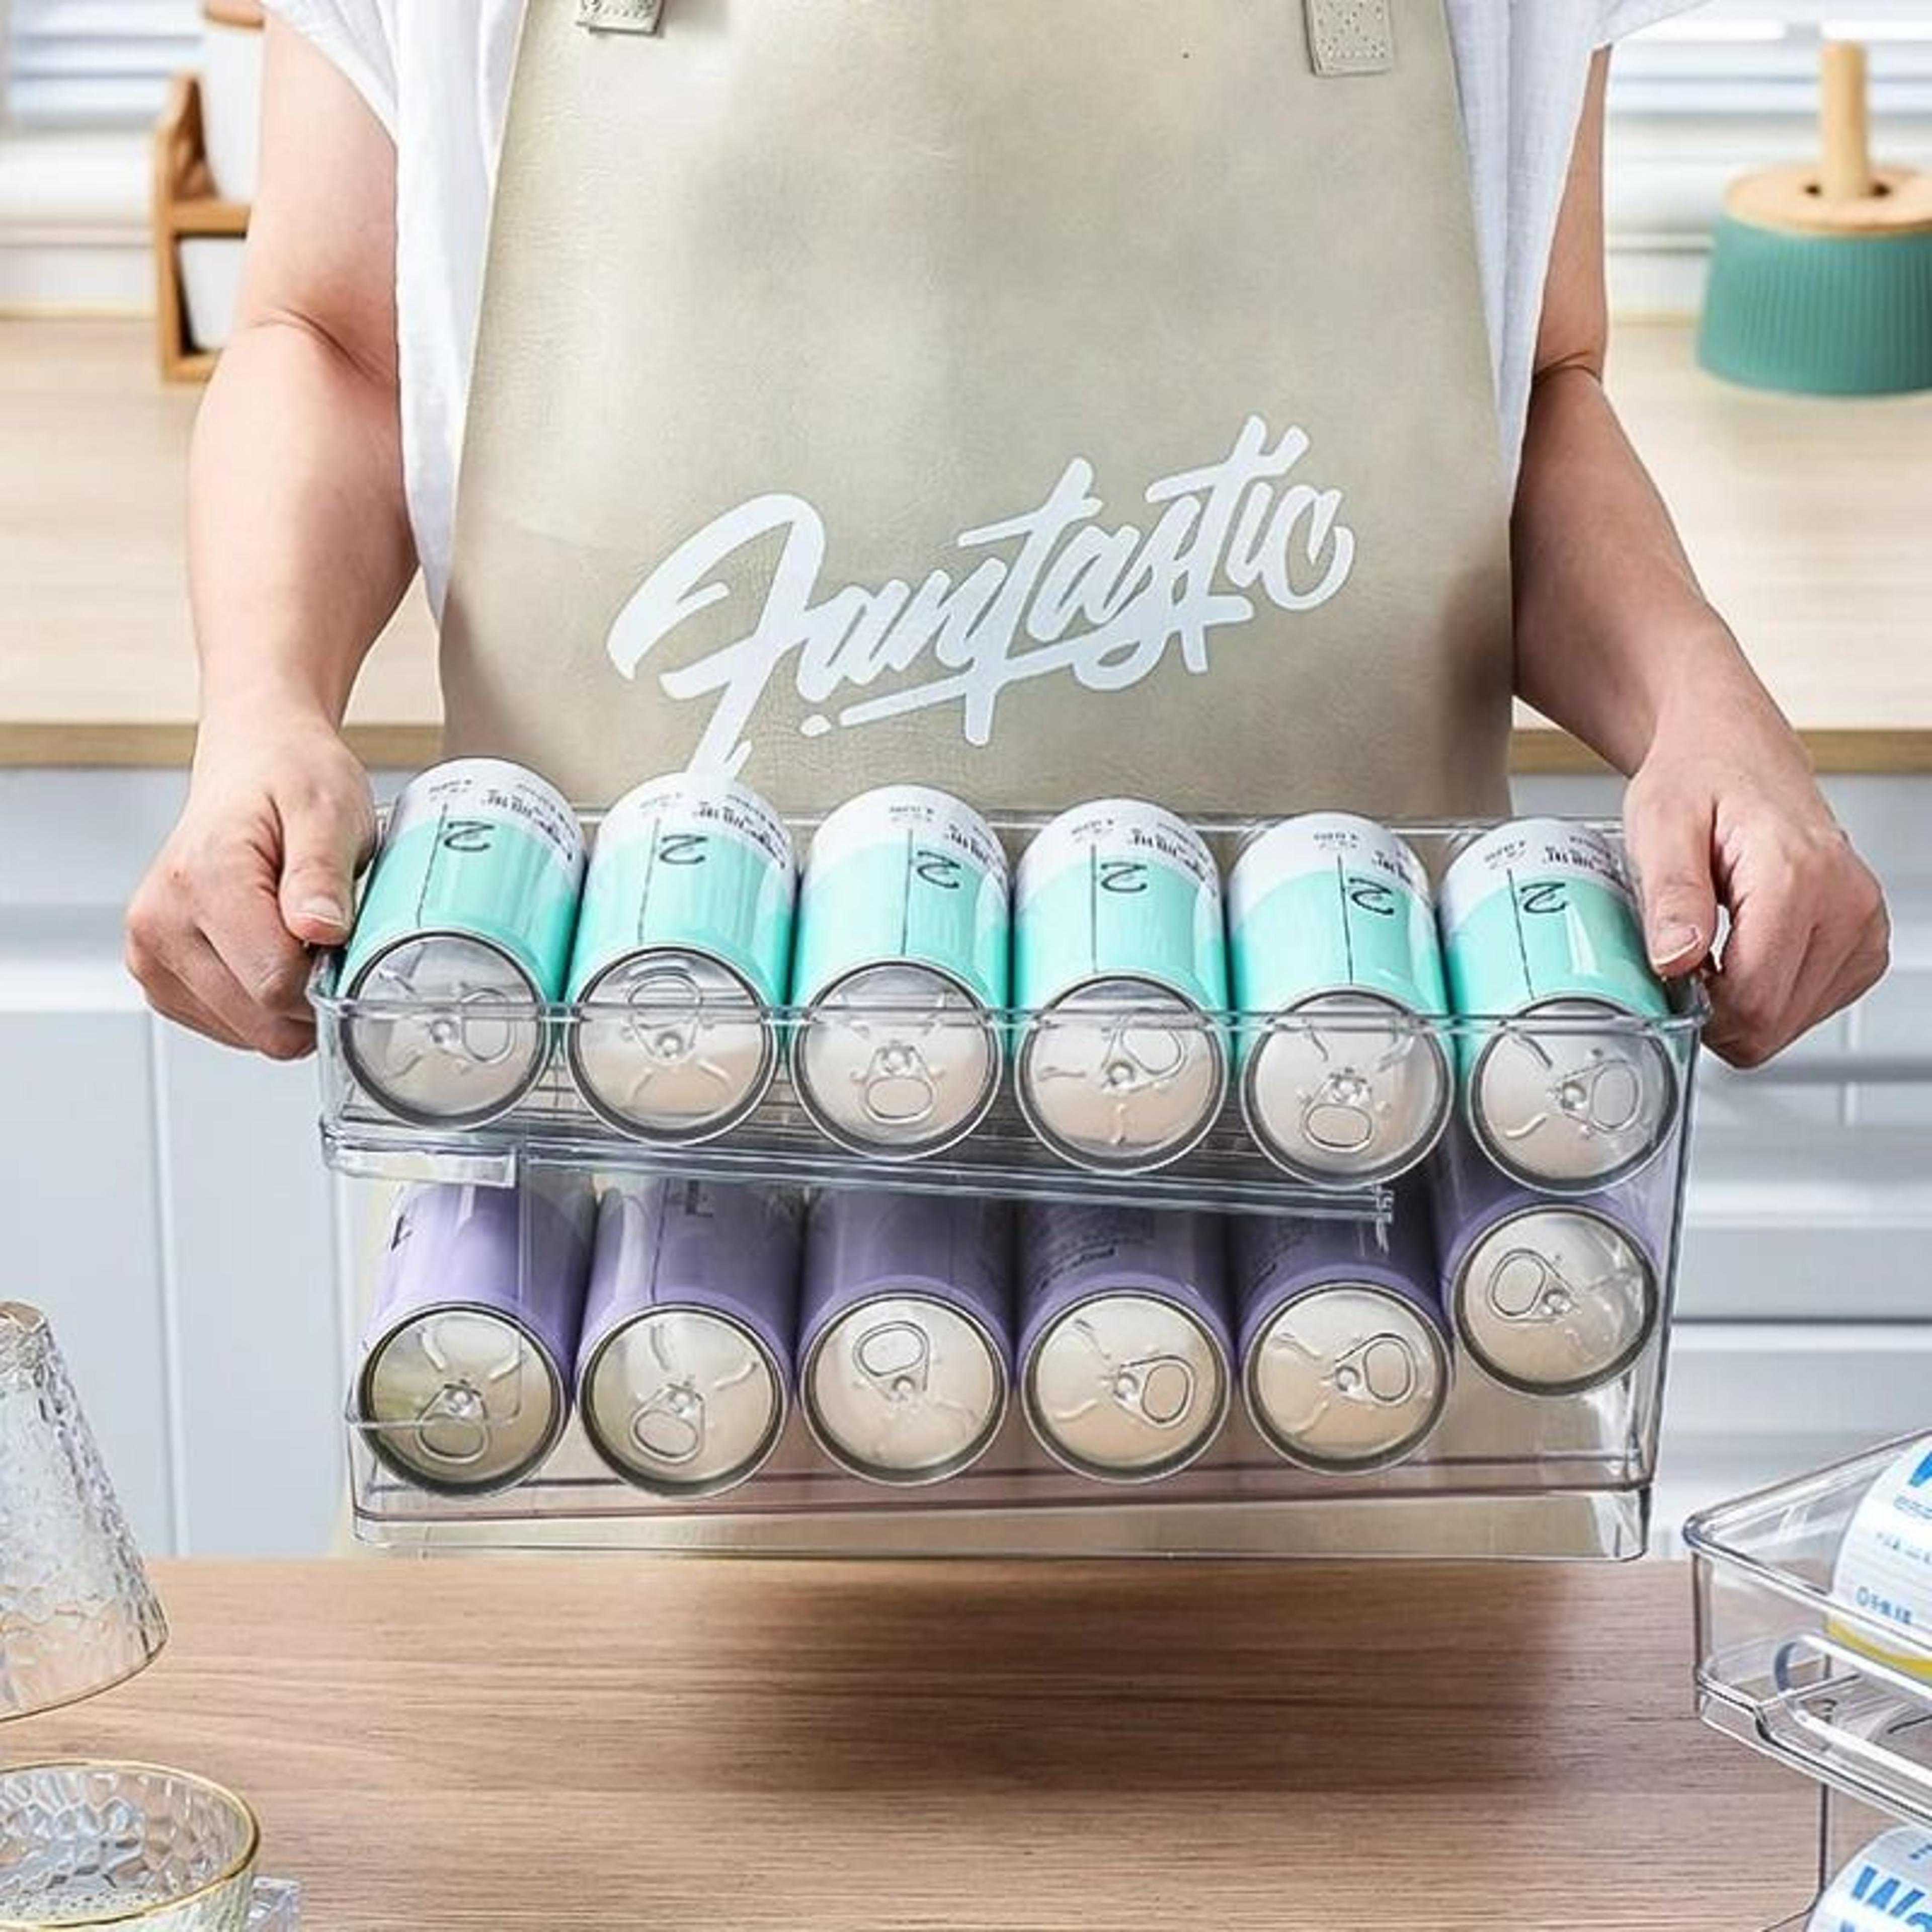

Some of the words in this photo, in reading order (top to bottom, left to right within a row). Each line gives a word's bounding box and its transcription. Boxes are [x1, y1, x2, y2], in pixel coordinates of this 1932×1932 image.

[606, 415, 1355, 783] Fantastic
[443, 820, 495, 852] 2
[660, 834, 708, 866] 2
[916, 850, 961, 890] 2
[1101, 862, 1148, 892] 2
[1348, 877, 1395, 916] 2
[1520, 881, 1567, 914] 2
